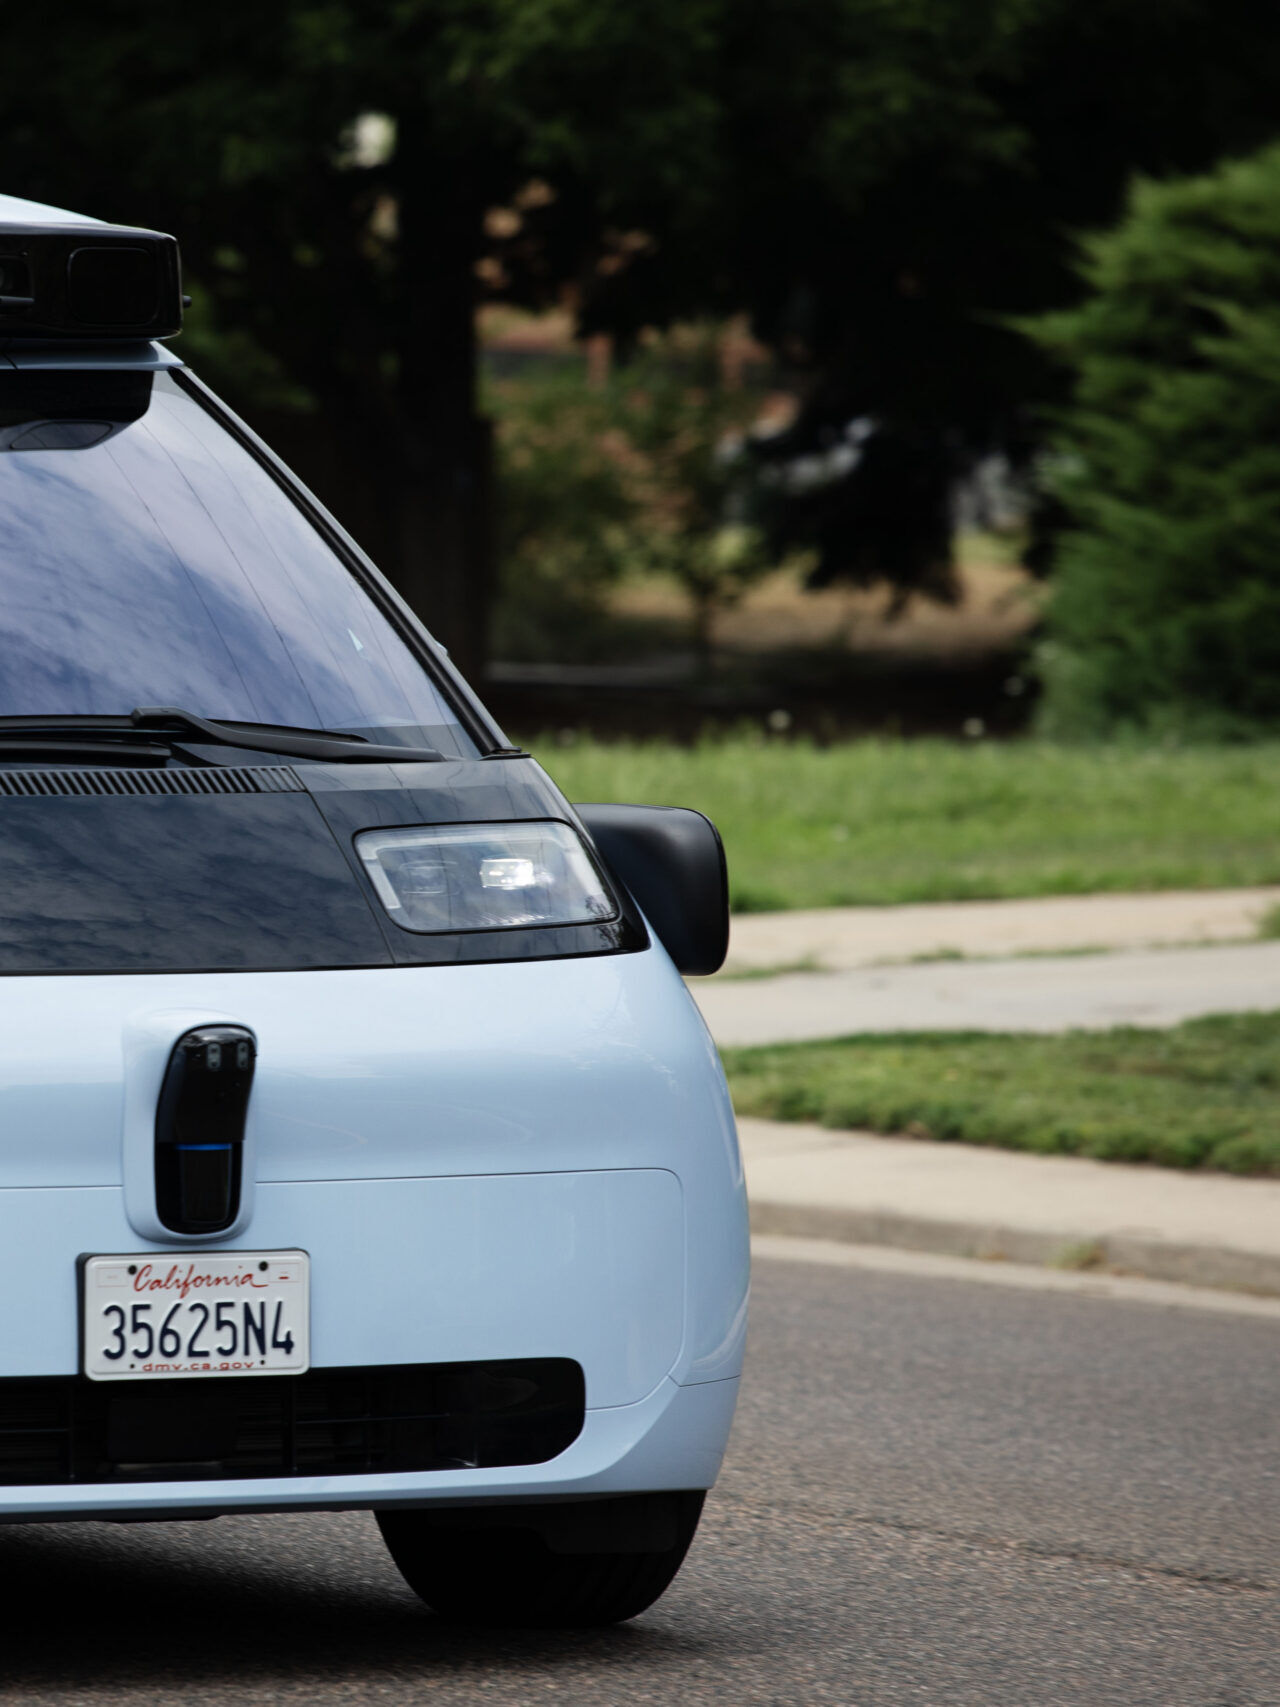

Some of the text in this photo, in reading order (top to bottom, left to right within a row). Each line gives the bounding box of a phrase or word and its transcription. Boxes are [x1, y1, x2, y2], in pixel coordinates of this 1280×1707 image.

[133, 1264, 269, 1299] California
[102, 1301, 294, 1360] 35625N4
[142, 1361, 254, 1372] dmv.ca.gov
